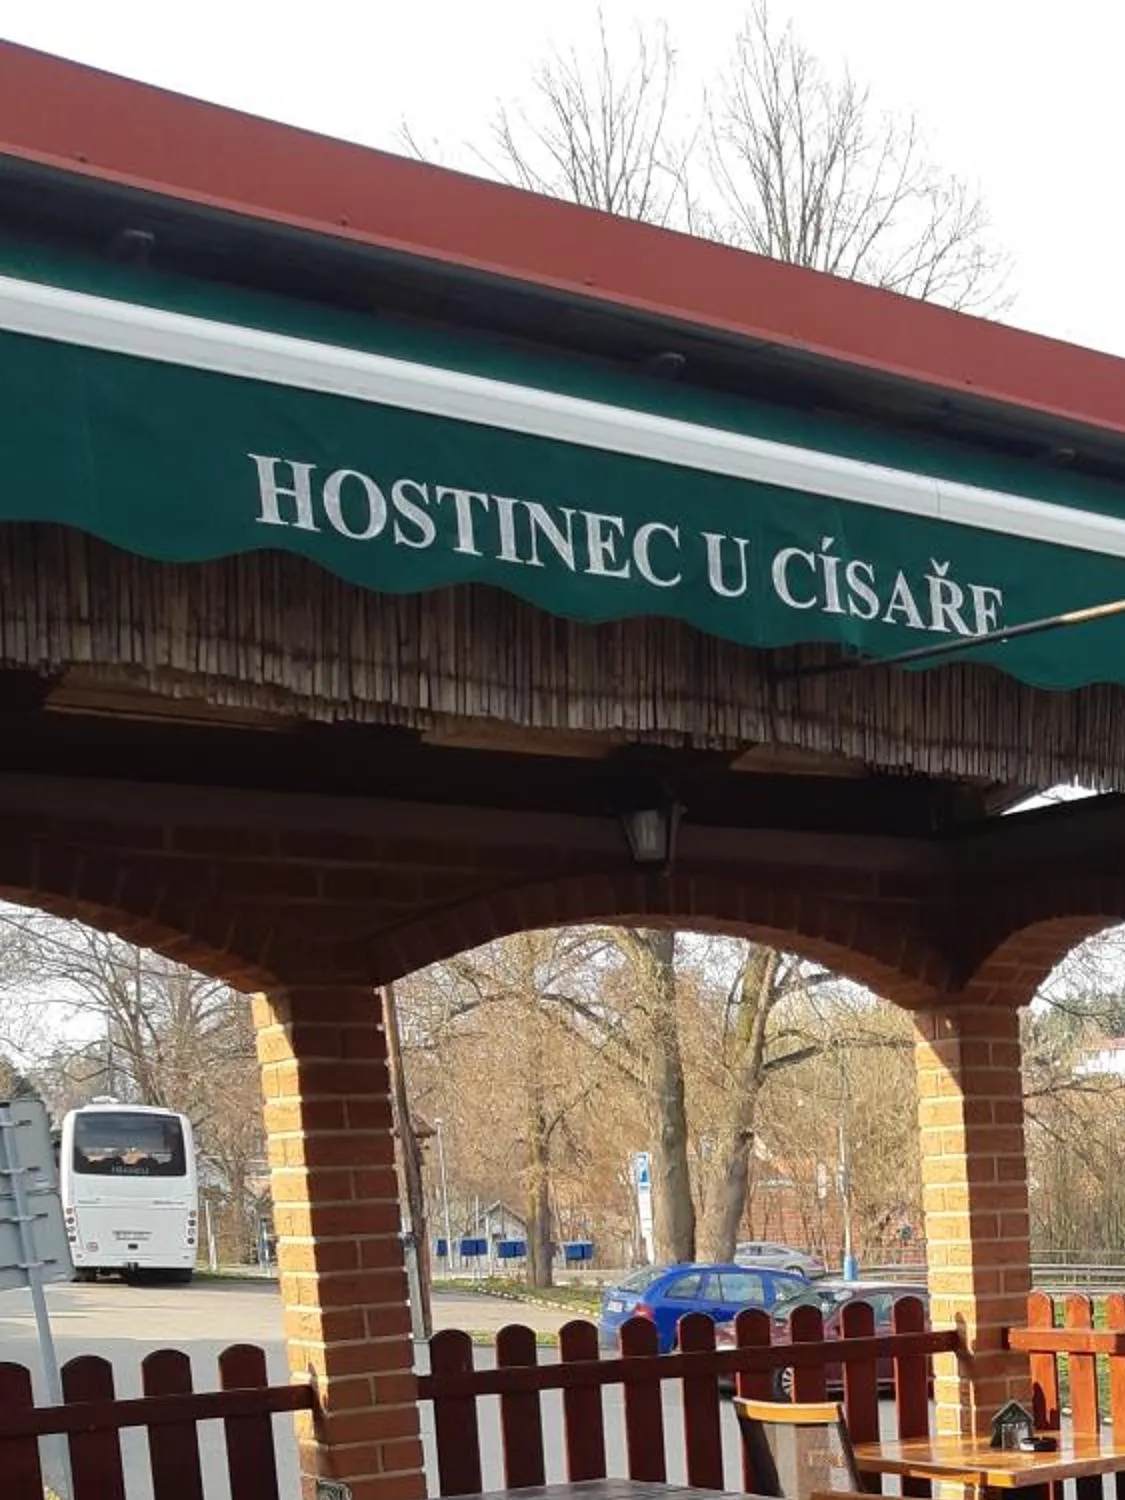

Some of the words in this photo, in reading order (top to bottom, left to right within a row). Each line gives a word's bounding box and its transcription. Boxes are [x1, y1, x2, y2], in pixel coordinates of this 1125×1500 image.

[247, 453, 682, 588] HOSTINEC
[700, 532, 750, 598] U
[771, 537, 1006, 643] CÍSAŘE
